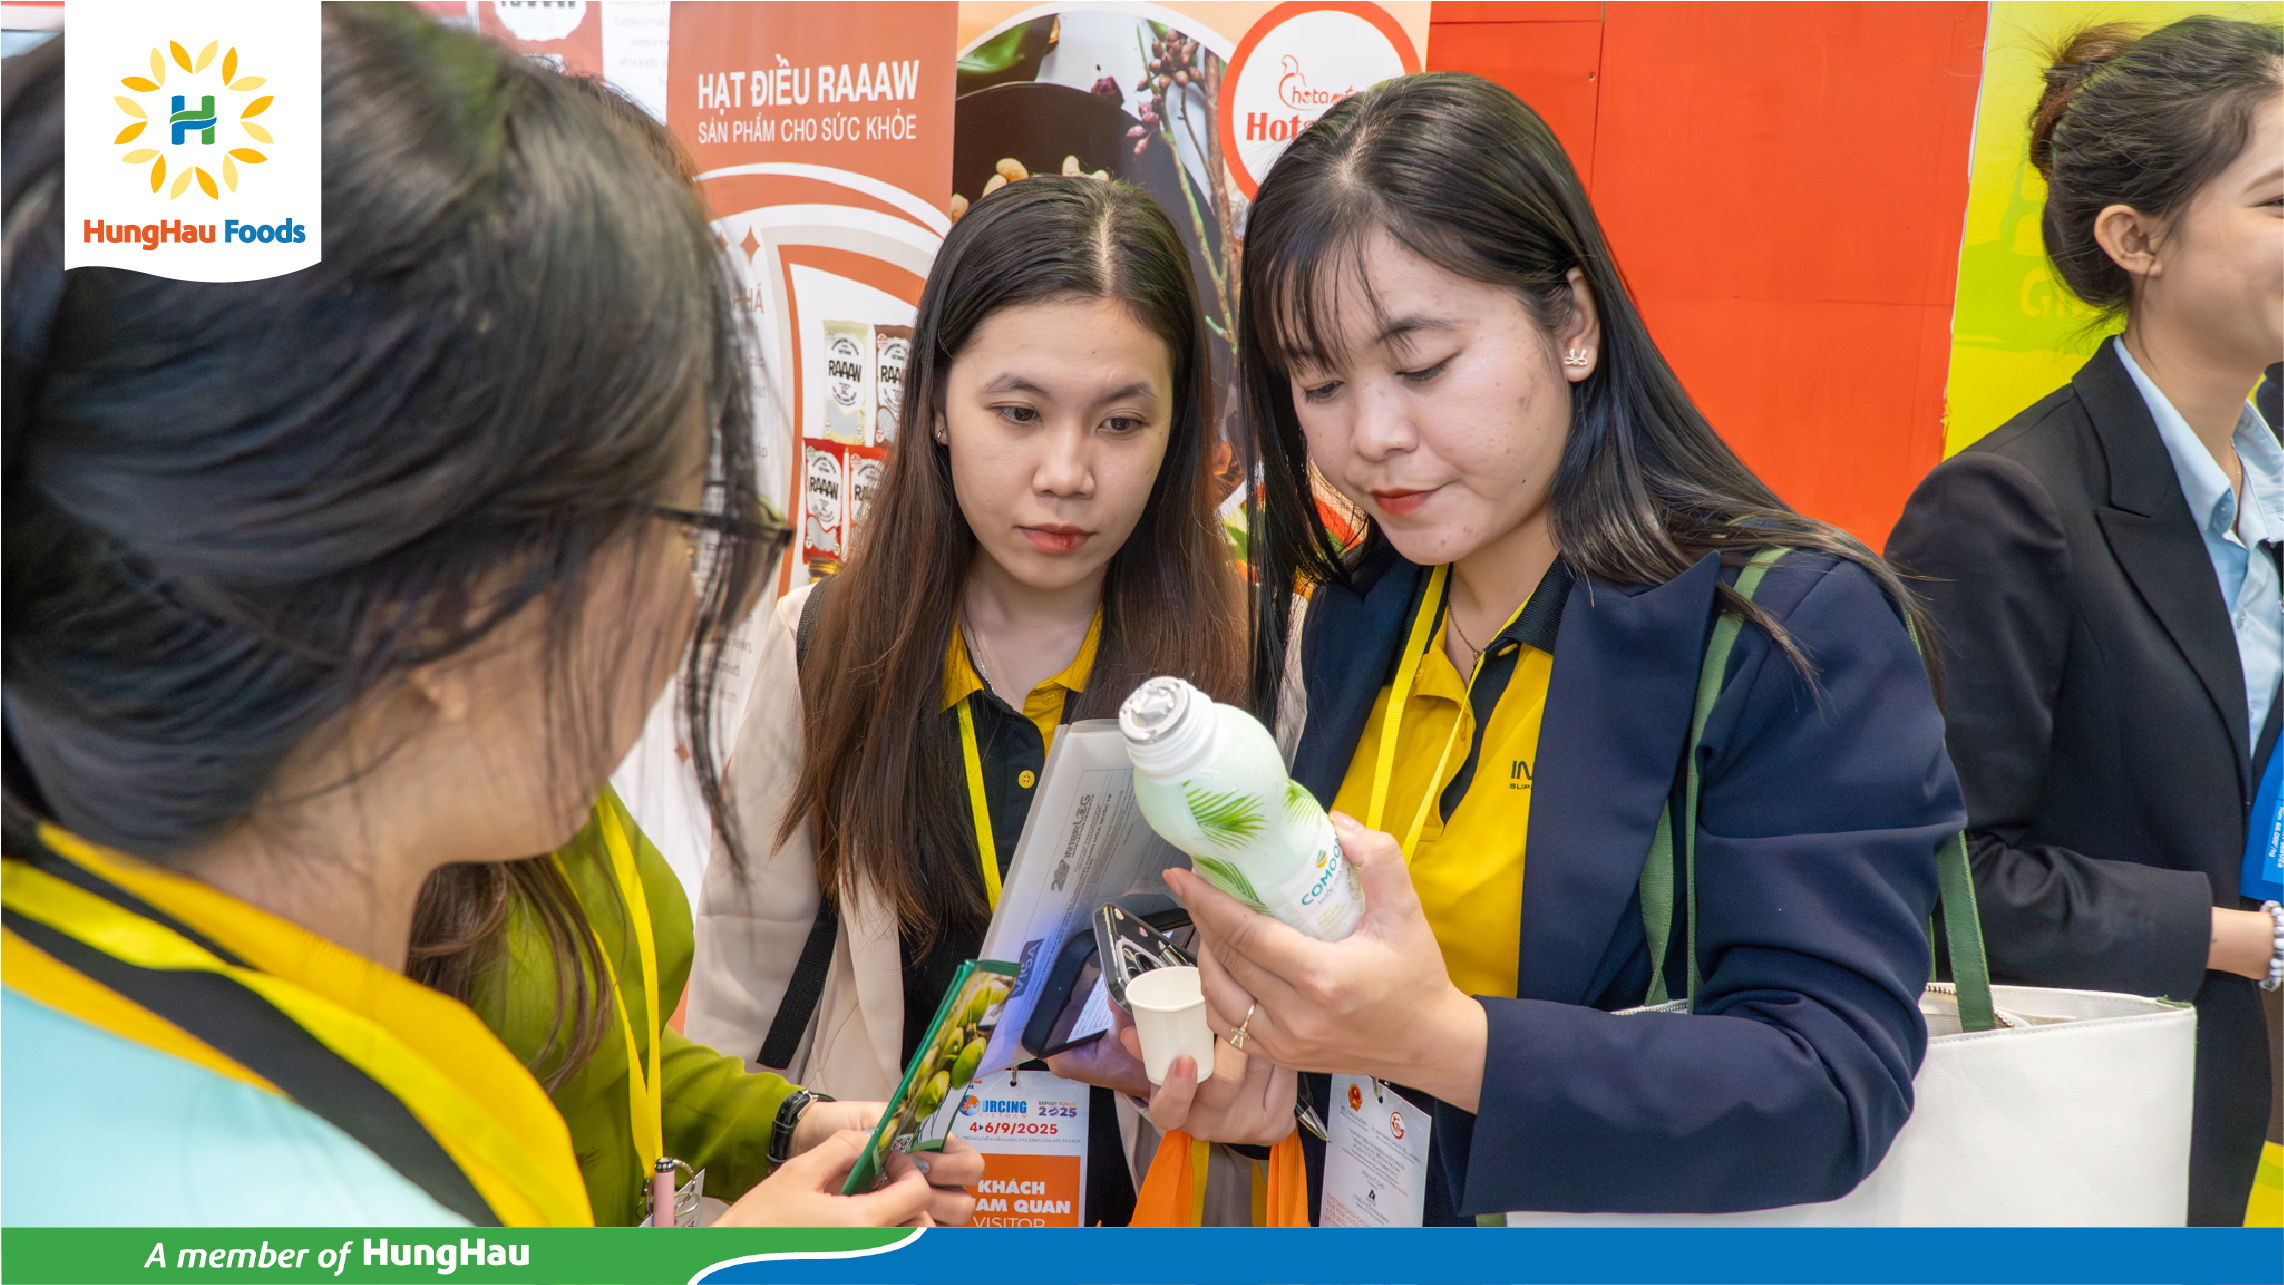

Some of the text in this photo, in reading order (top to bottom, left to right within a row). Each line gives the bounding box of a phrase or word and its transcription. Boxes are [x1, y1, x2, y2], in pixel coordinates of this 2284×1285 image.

[698, 53, 920, 116] HẠT ĐIỀU RAAAW
[698, 108, 917, 143] SẢN PHẨM CHO SỨC KHỎE
[1246, 112, 1317, 142] Hot
[828, 359, 862, 383] RAAAW
[880, 365, 903, 384] RAA
[809, 476, 839, 500] RAAAW
[977, 1178, 1046, 1195] KHÁCH
[973, 1198, 1071, 1214] AM QUAN
